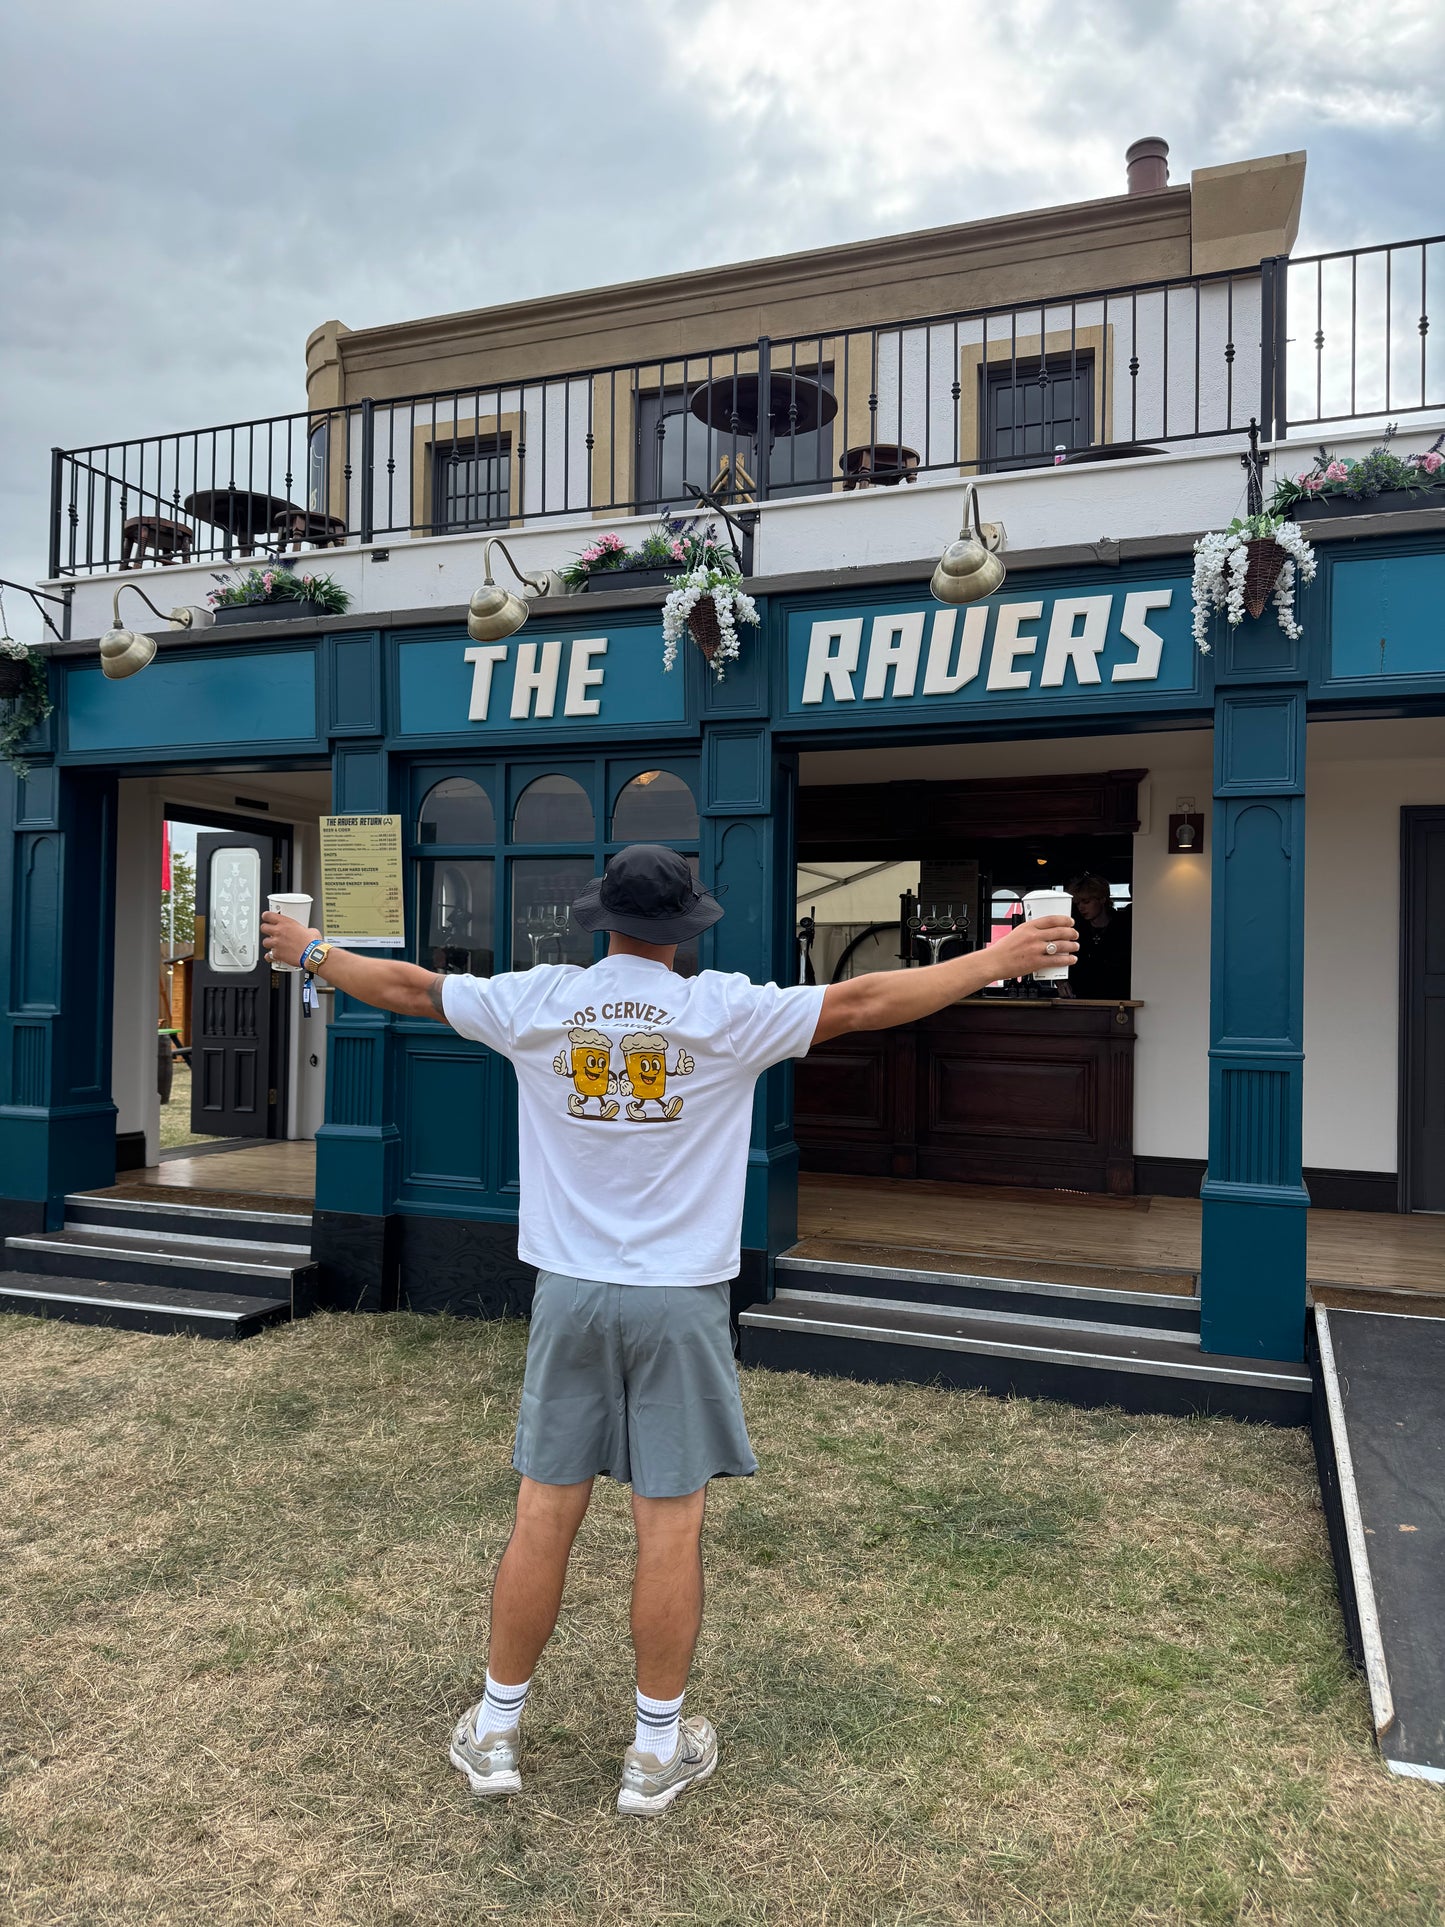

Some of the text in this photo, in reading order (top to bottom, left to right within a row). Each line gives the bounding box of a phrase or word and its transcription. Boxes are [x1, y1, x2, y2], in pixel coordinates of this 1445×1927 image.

[463, 589, 1173, 722] THE RAVERS
[326, 817, 382, 826] THE RAVERS RETURN
